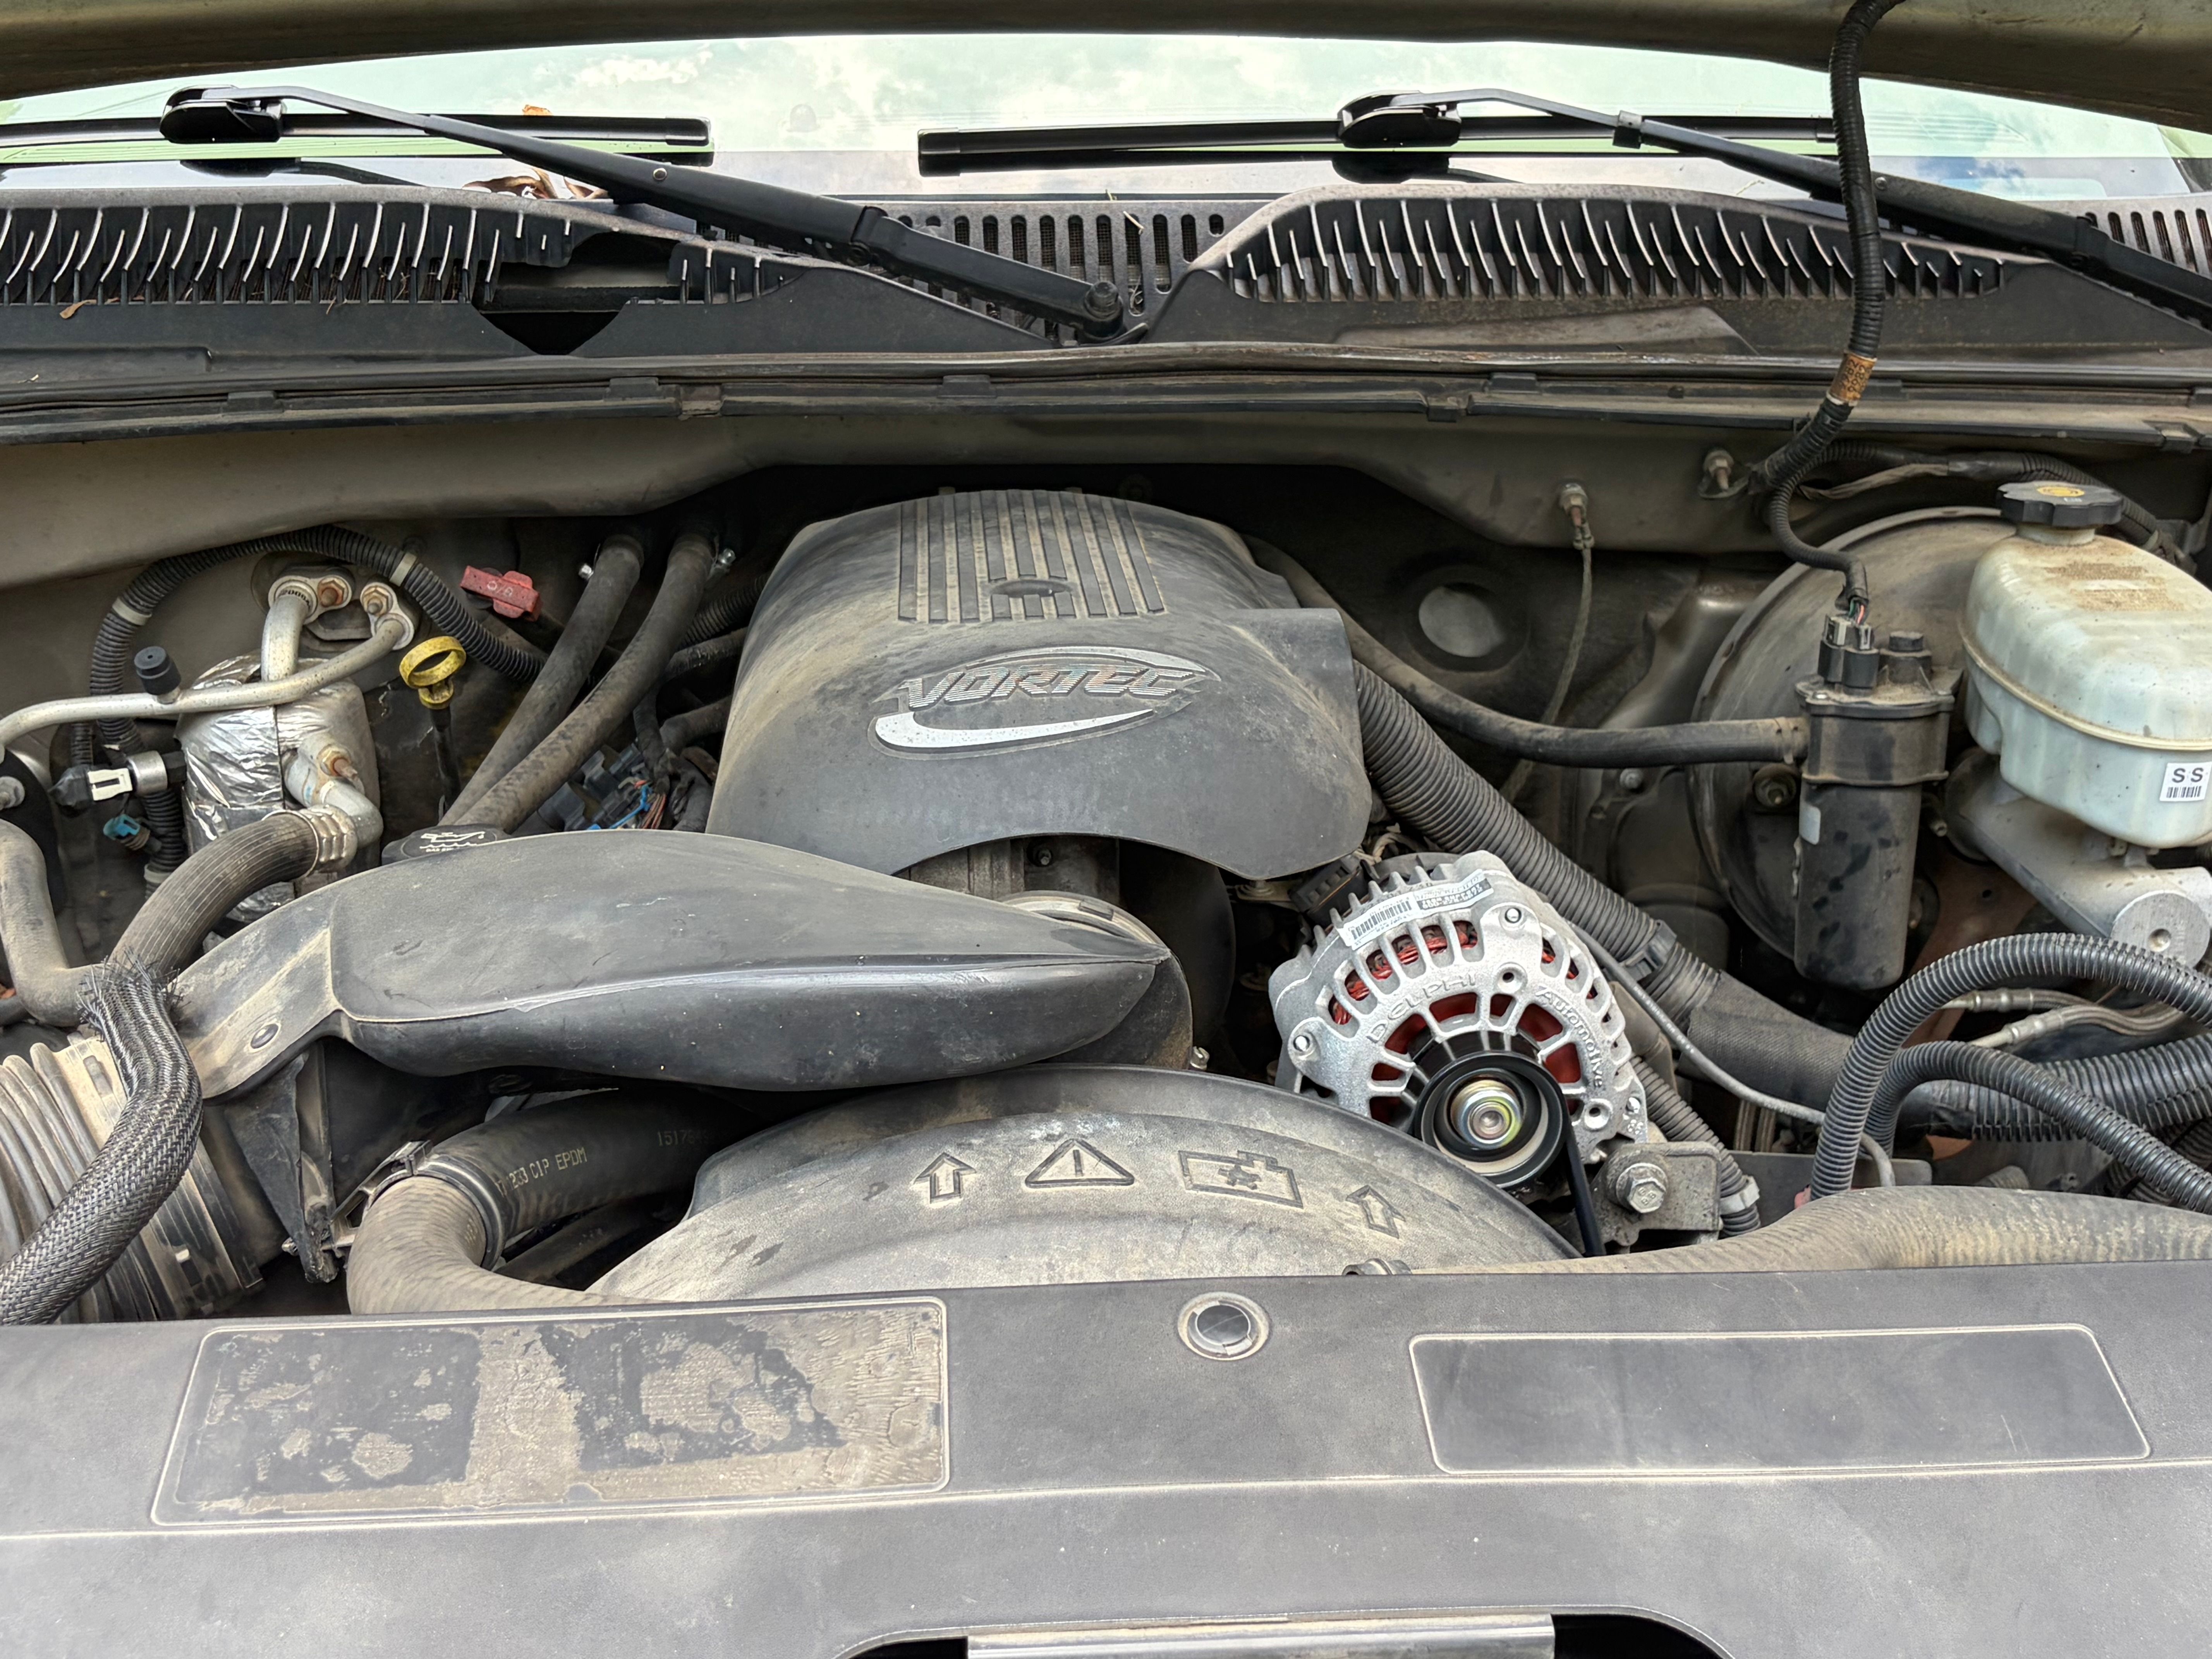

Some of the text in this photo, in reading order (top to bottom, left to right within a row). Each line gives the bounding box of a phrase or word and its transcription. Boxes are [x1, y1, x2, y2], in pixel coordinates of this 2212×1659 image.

[898, 664, 1194, 708] VORTEC
[1365, 973, 1476, 1044] DELPHI
[1535, 986, 1603, 1087] Automotive
[555, 1147, 587, 1170] EPDM
